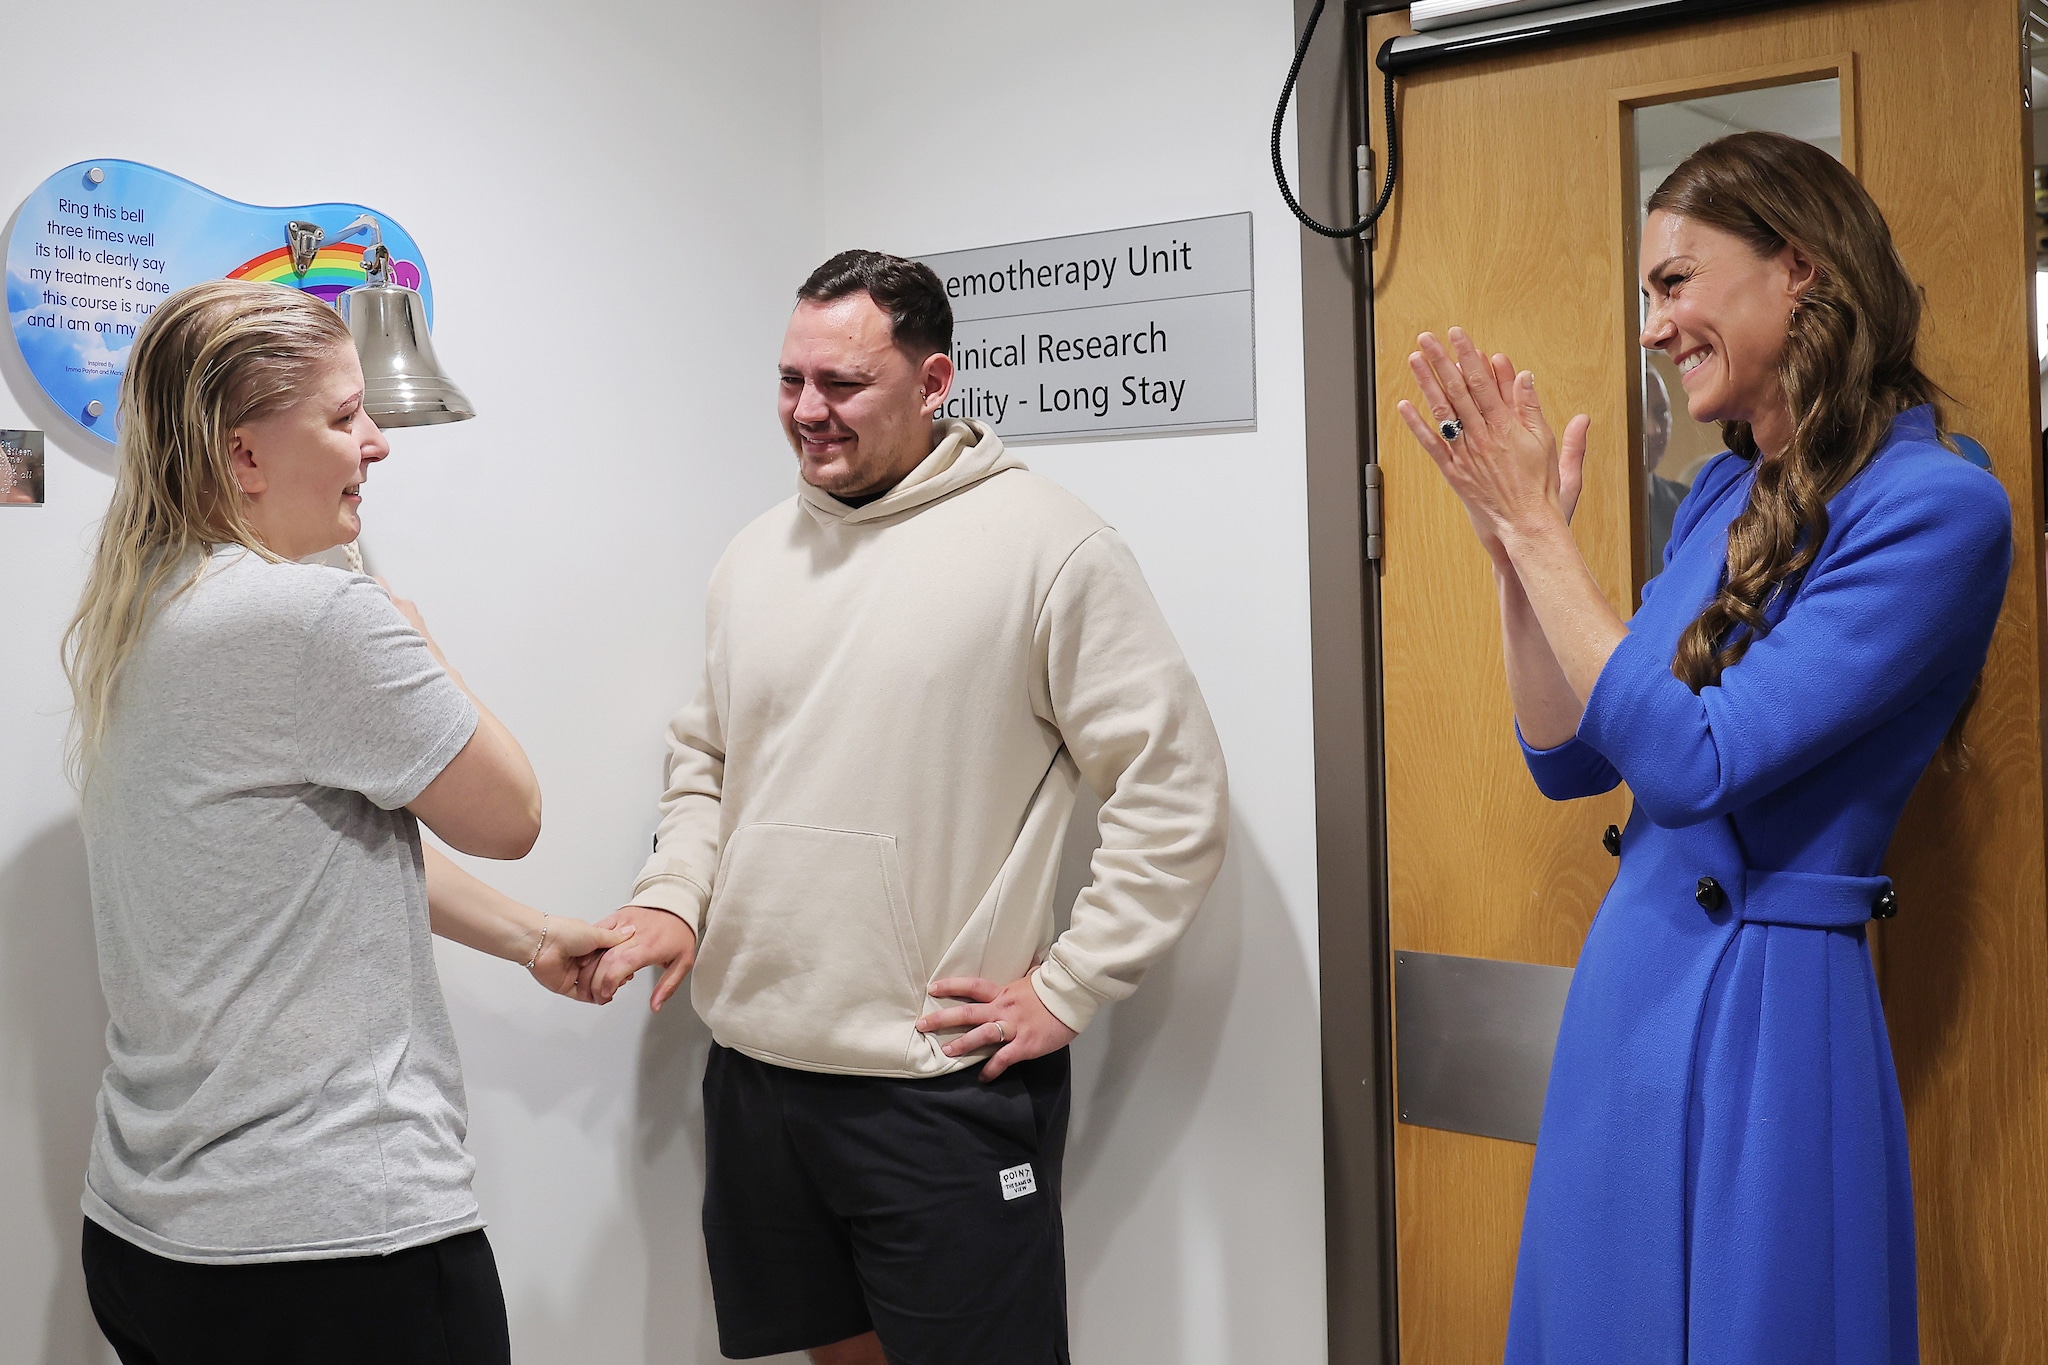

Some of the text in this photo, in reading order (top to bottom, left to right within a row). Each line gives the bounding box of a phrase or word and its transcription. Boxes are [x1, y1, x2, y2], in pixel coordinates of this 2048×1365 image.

[59, 198, 144, 223] Ring this bell
[47, 220, 154, 247] three times well
[35, 242, 166, 274] its toll to clearly say
[946, 239, 1192, 298] emotherapy Unit
[30, 268, 170, 294] my treatment's done
[42, 289, 67, 306] this
[71, 296, 117, 311] course
[121, 299, 132, 312] is
[27, 314, 137, 339] and I am on my
[950, 321, 1167, 371] linical Research
[932, 387, 1009, 424] acility
[1039, 383, 1109, 417] Long
[1122, 375, 1186, 411] Stay
[1003, 1169, 1030, 1182] POINT
